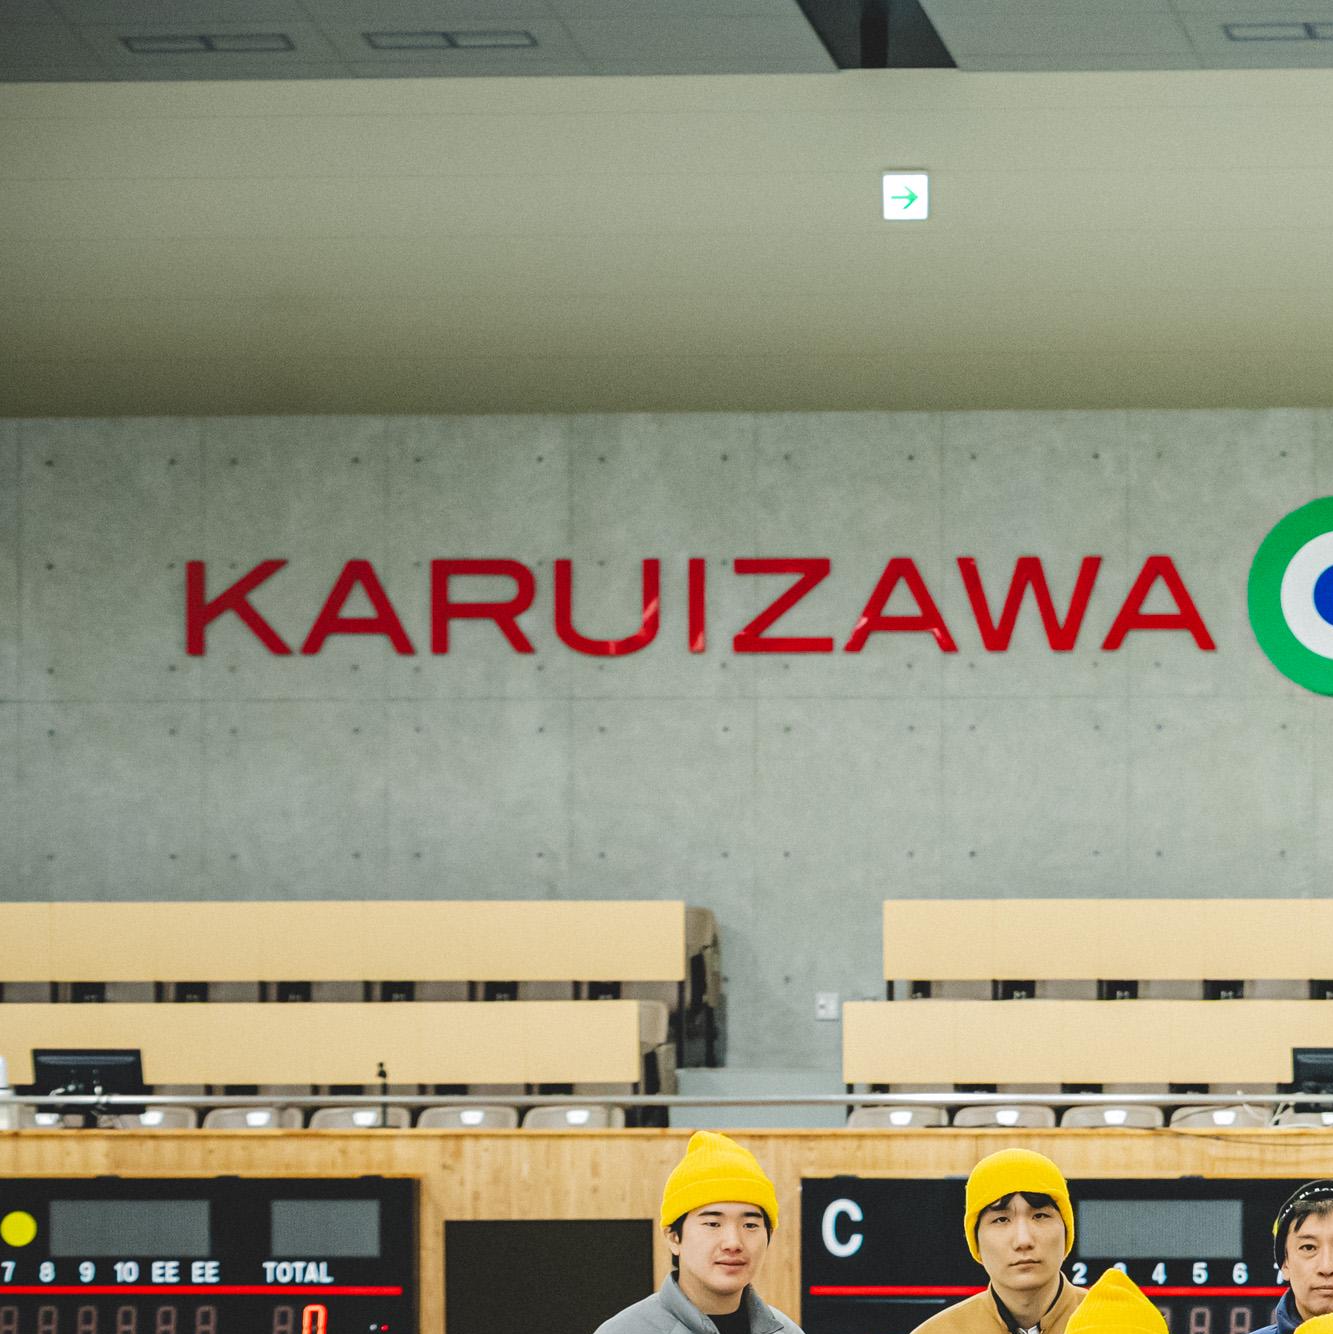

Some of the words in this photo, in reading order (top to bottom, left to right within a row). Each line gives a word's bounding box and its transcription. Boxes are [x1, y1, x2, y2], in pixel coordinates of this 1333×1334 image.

[185, 554, 1217, 657] KARUIZAWA
[821, 1198, 863, 1258] C
[1, 1261, 16, 1283] 7
[39, 1261, 55, 1283] 8
[78, 1261, 95, 1283] 9
[113, 1261, 139, 1283] 10
[151, 1261, 180, 1283] EE
[191, 1261, 220, 1283] EE
[262, 1261, 334, 1284] TOTAL
[1071, 1262, 1087, 1285] 2
[1151, 1262, 1167, 1285] 4
[1192, 1262, 1208, 1285] 5
[1232, 1262, 1247, 1285] 6
